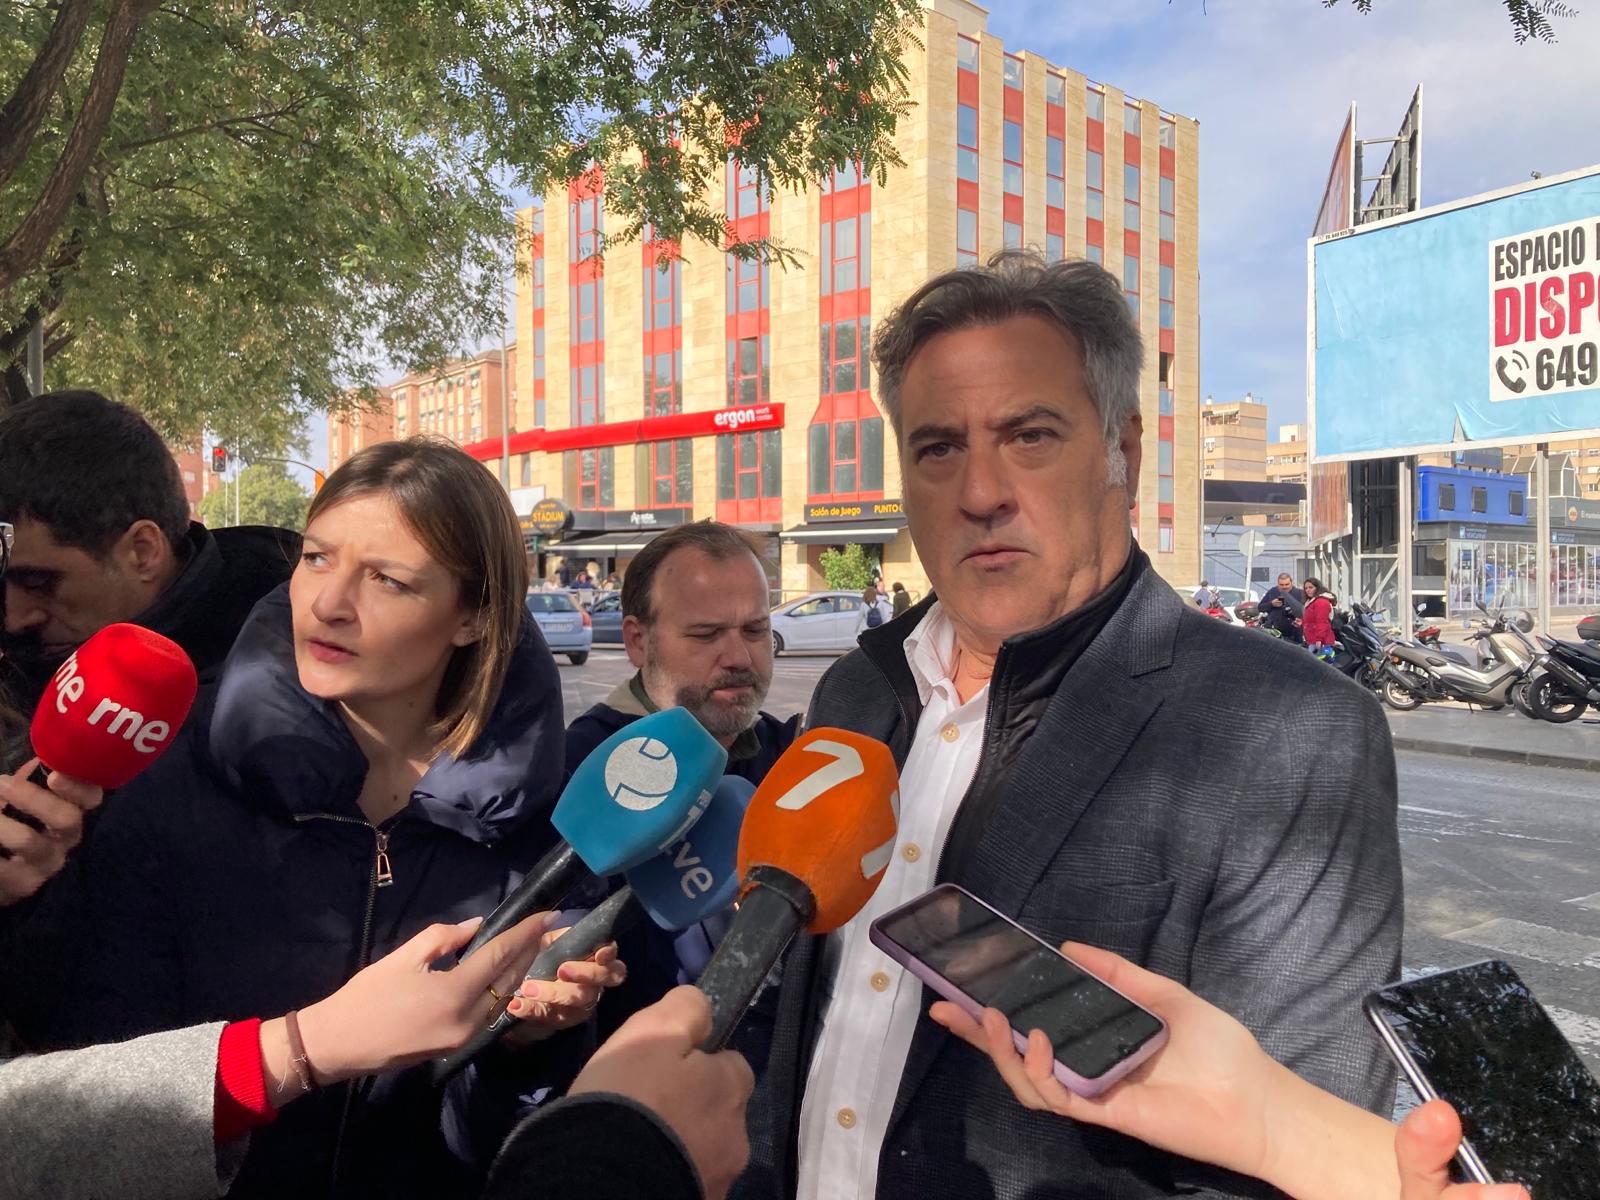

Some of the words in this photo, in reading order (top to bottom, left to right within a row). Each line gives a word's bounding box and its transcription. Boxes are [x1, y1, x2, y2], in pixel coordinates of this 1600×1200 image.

[1495, 226, 1585, 282] ESPACIO
[1494, 271, 1600, 347] DISP
[1536, 341, 1598, 391] 649
[714, 409, 755, 428] ergon
[533, 511, 564, 521] STADIUM
[874, 504, 898, 513] PUNTO
[88, 697, 170, 753] rne
[775, 739, 865, 810] 7
[666, 836, 713, 899] ve
